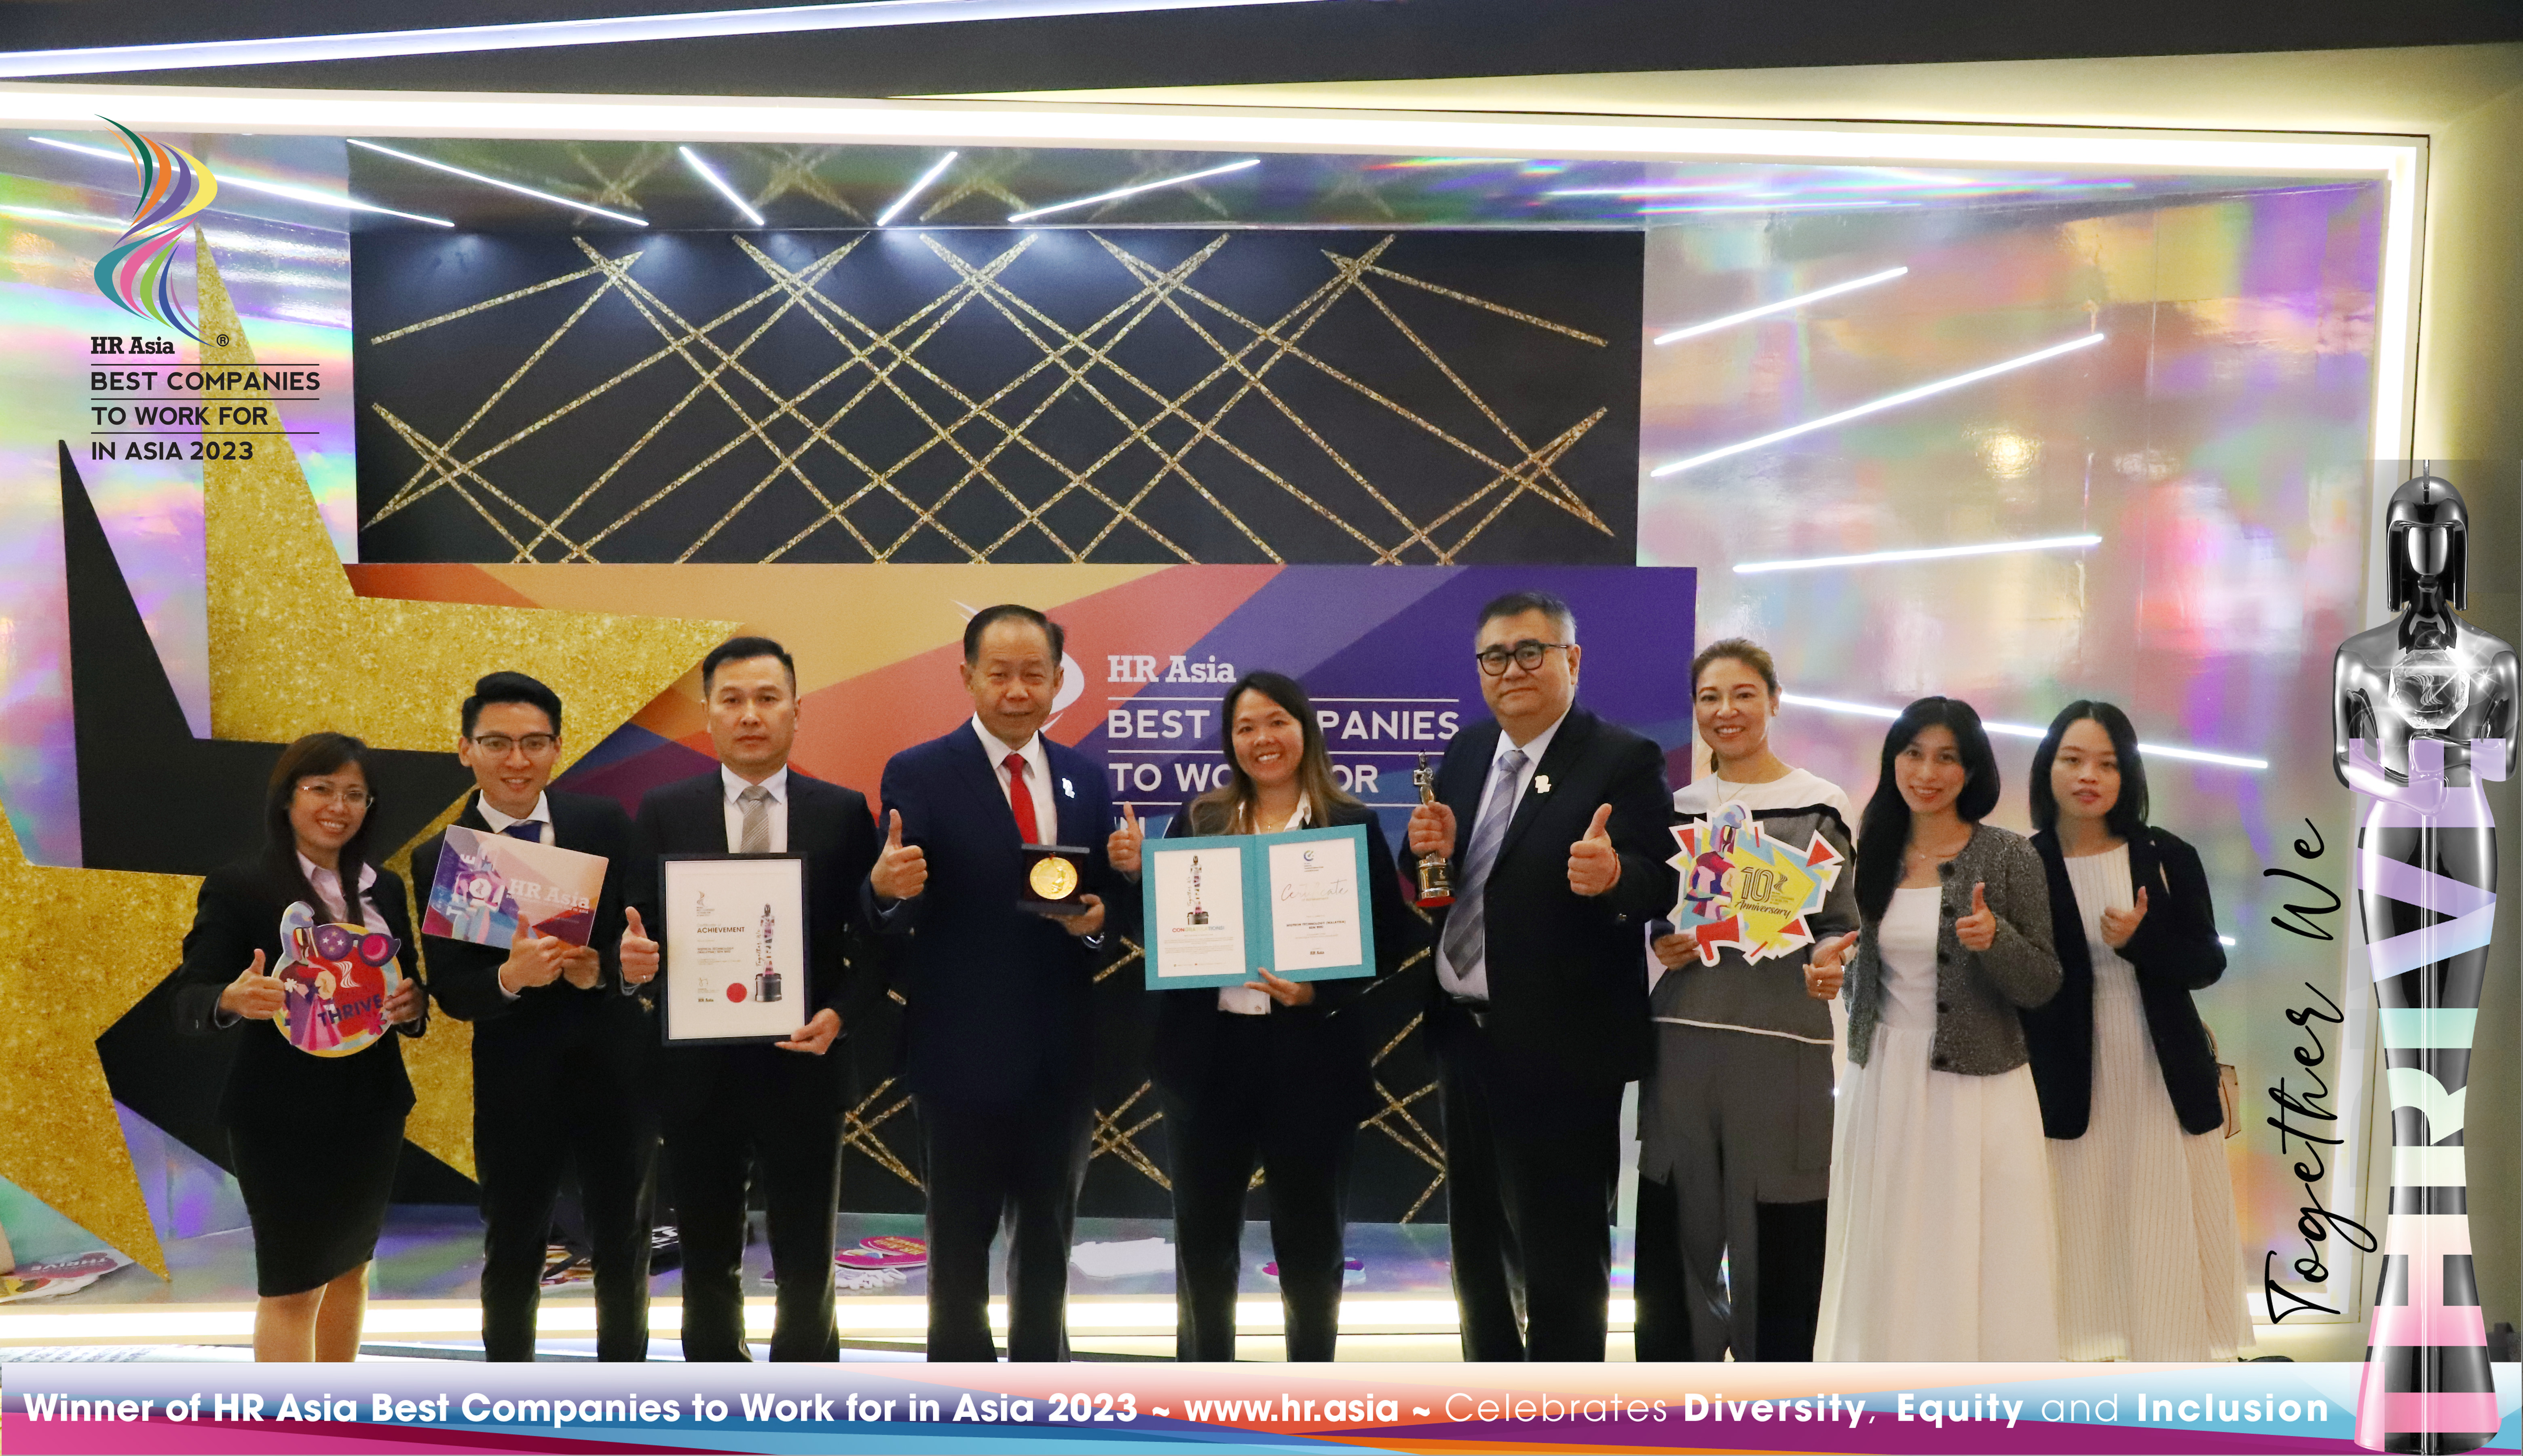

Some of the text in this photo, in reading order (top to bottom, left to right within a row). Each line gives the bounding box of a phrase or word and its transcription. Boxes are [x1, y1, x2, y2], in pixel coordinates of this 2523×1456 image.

[1107, 655, 1237, 684] HR Asia
[1108, 709, 1459, 741] BEST PANIES
[1109, 763, 1162, 792] TO
[1332, 764, 1379, 793] OR
[507, 878, 541, 899] HR
[544, 886, 590, 909] Asia
[1741, 867, 1774, 903] 10
[1734, 899, 1791, 920] Anniversary
[317, 994, 383, 1027] THRIVE
